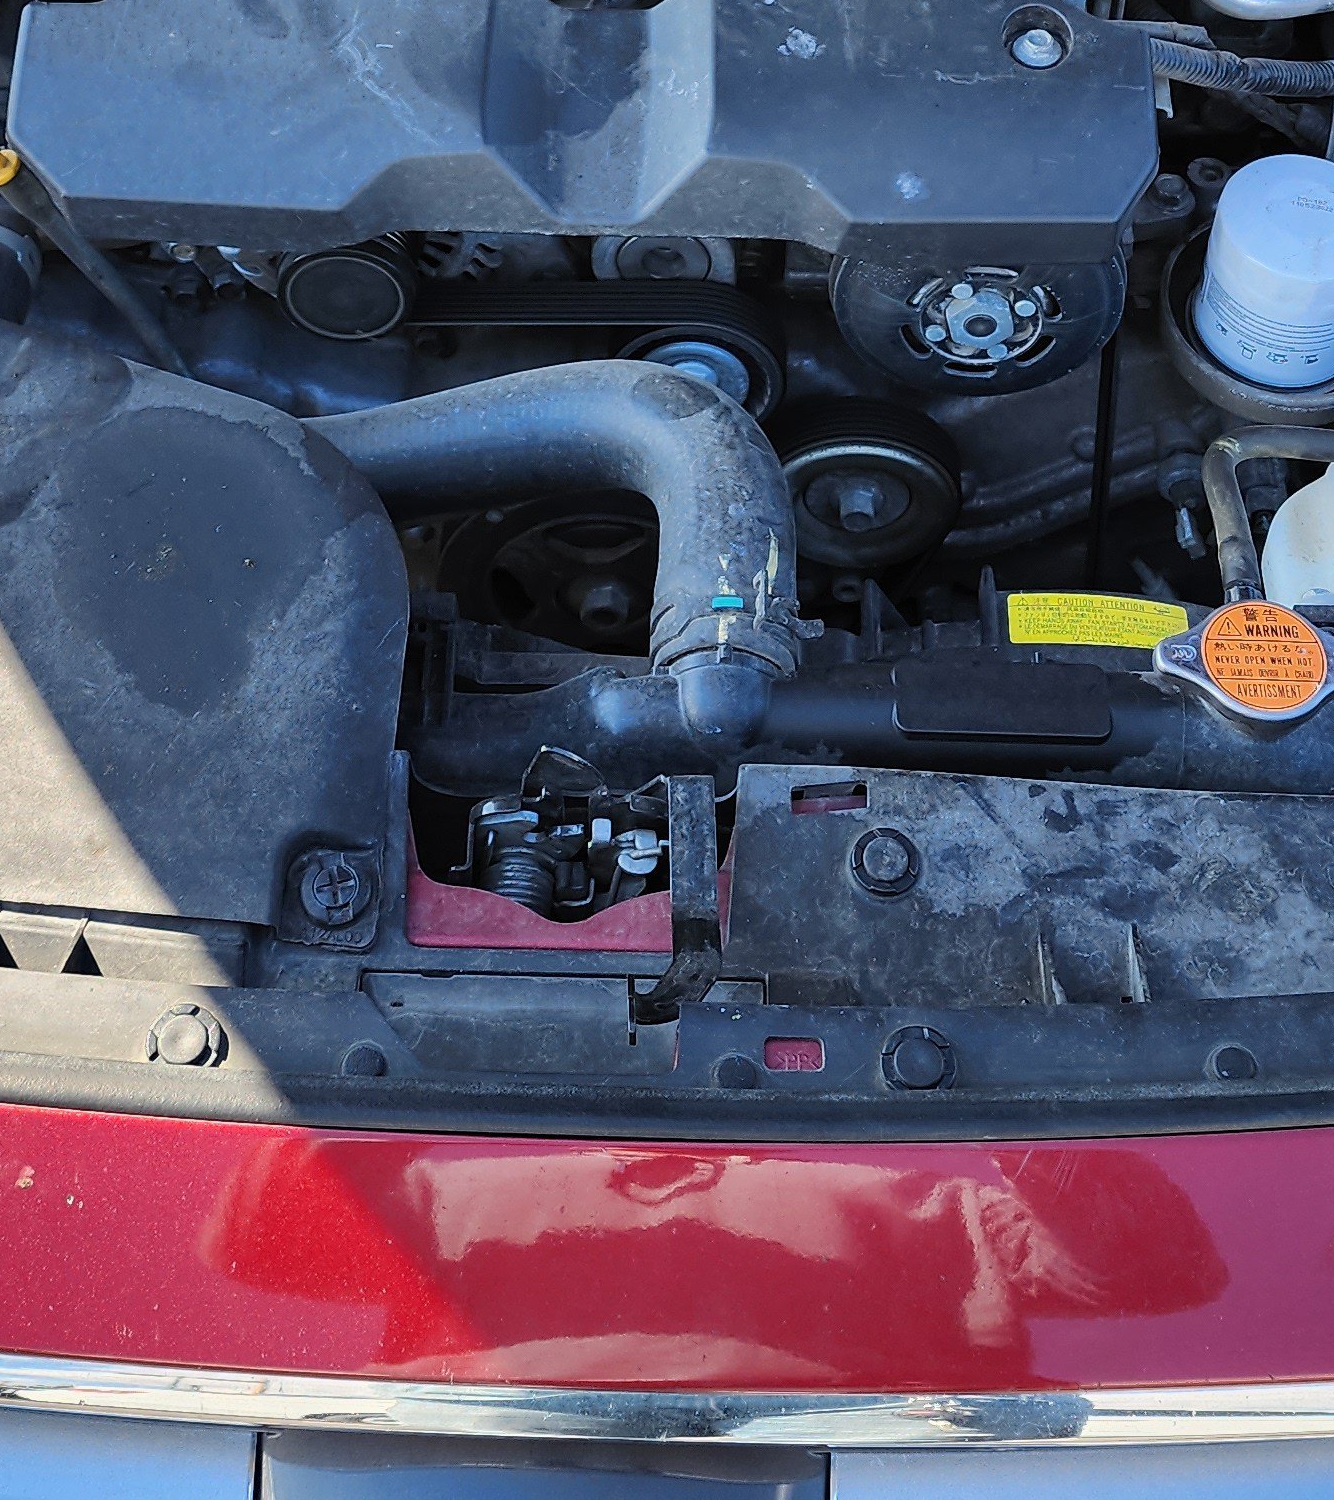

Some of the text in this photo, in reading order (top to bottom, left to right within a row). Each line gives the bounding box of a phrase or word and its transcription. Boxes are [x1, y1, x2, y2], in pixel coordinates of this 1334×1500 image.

[1058, 597, 1094, 607] CAUTION
[1100, 600, 1145, 612] ATTENTION
[1243, 607, 1278, 622] 警告
[1244, 624, 1299, 639] WARNING
[1215, 655, 1240, 664] NEVER
[1245, 656, 1266, 665] OPEN
[1270, 657, 1292, 666] WHEN
[1237, 683, 1302, 698] AVERTISSMENT
